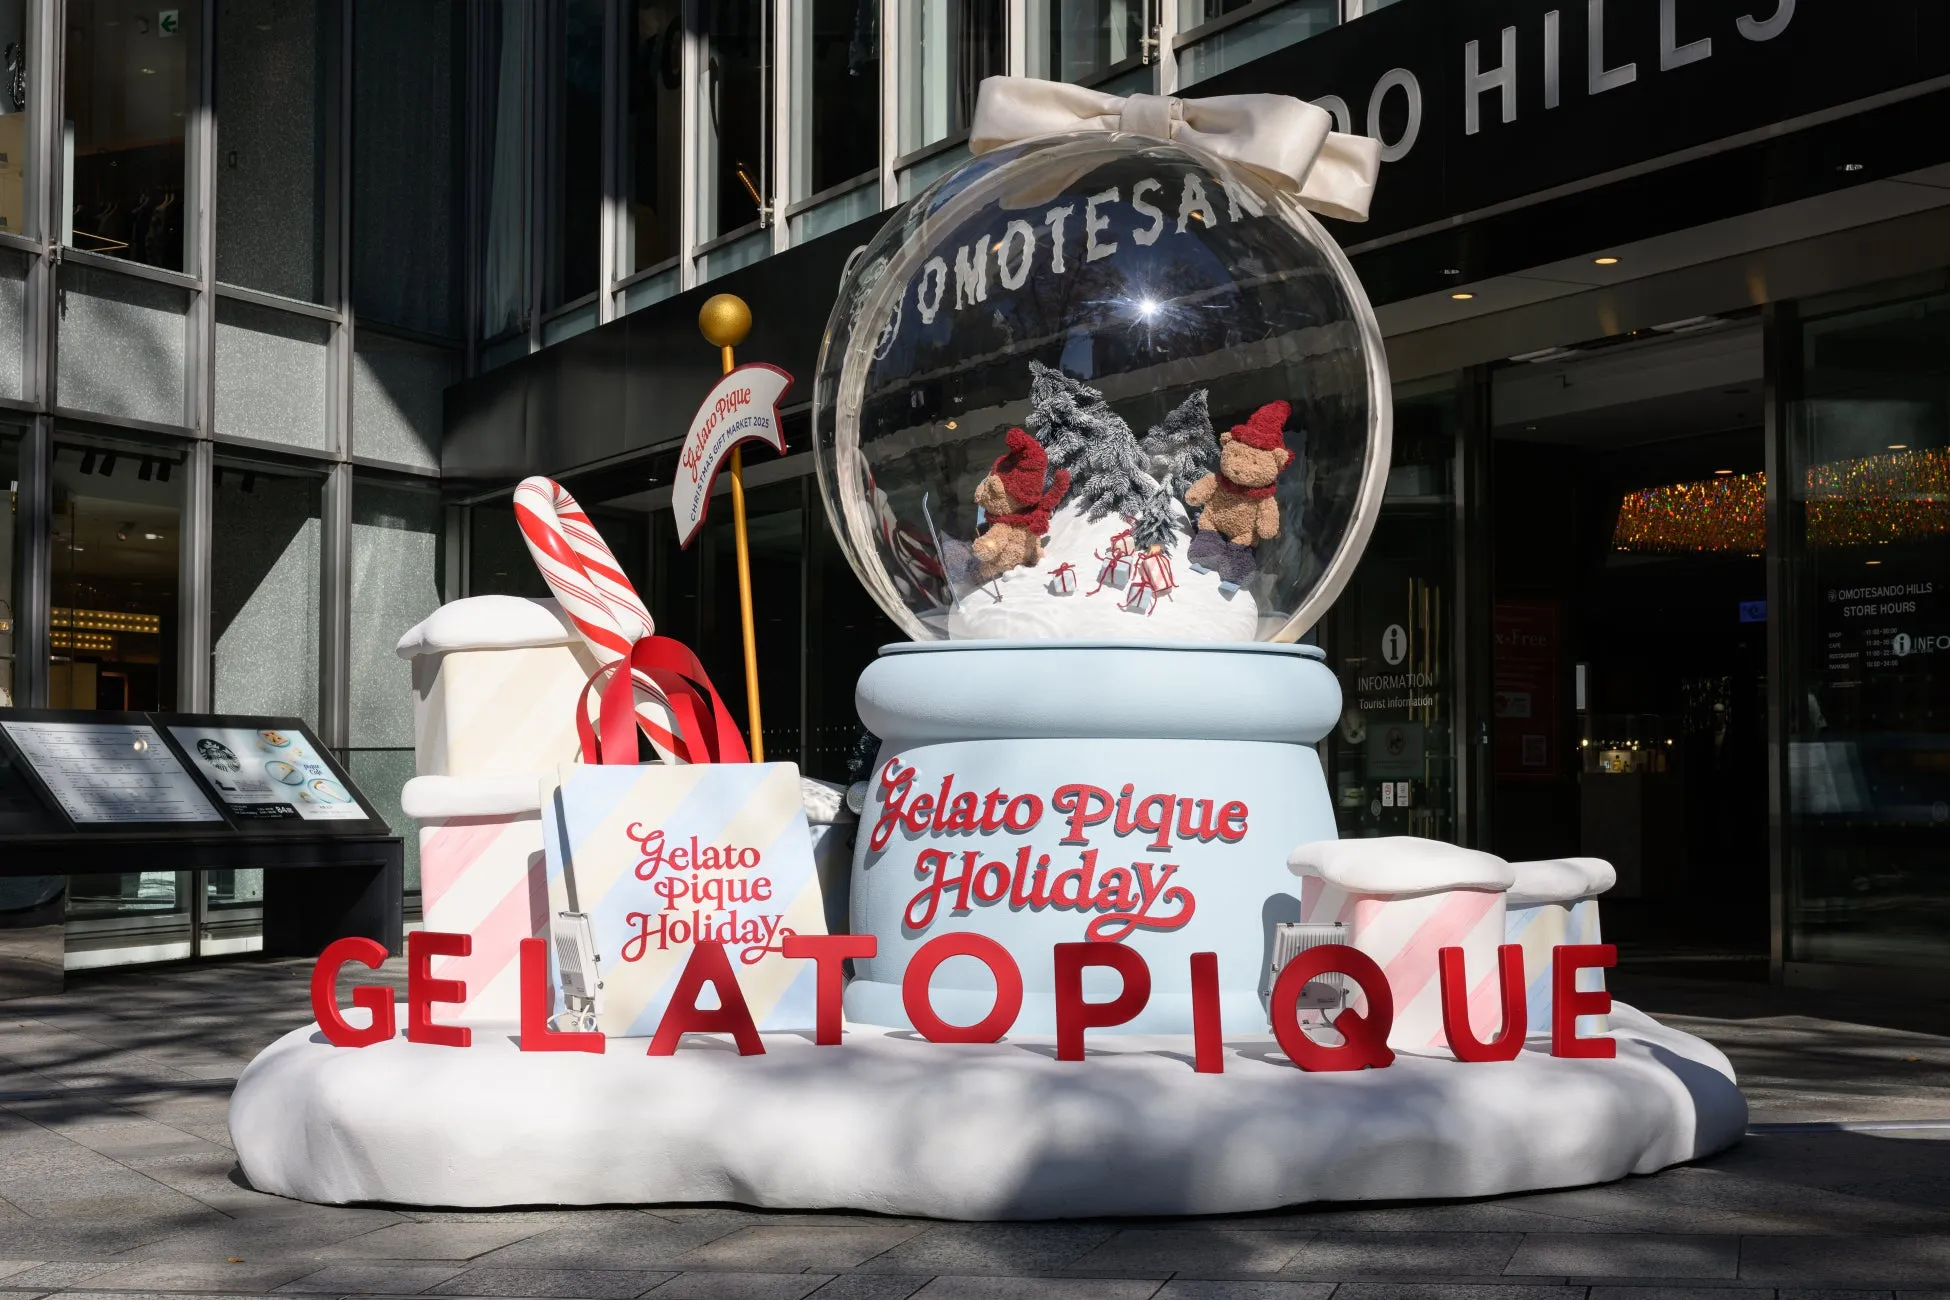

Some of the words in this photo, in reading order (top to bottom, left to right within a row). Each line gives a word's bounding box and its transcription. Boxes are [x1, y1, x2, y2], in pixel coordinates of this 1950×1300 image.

[683, 412, 717, 483] Gelato
[716, 387, 751, 421] Pique
[690, 455, 714, 522] CHRISTMAS
[712, 433, 727, 455] GIFT
[726, 416, 752, 438] MARKET
[753, 416, 769, 429] 2025
[1838, 585, 1904, 600] OMOTESANDO
[1906, 582, 1933, 594] HILLS
[1843, 604, 1877, 617] STORE
[1880, 601, 1916, 614] HOURS
[1358, 673, 1433, 691] INFORMATION
[1359, 698, 1386, 709] Tourist
[1387, 696, 1433, 708] Information
[870, 757, 1045, 853] Gelato
[1052, 782, 1249, 850] Pique
[626, 822, 761, 881] Gelato
[654, 873, 772, 911] Pique
[904, 845, 1196, 944] Holiday
[621, 909, 798, 965] Holiday
